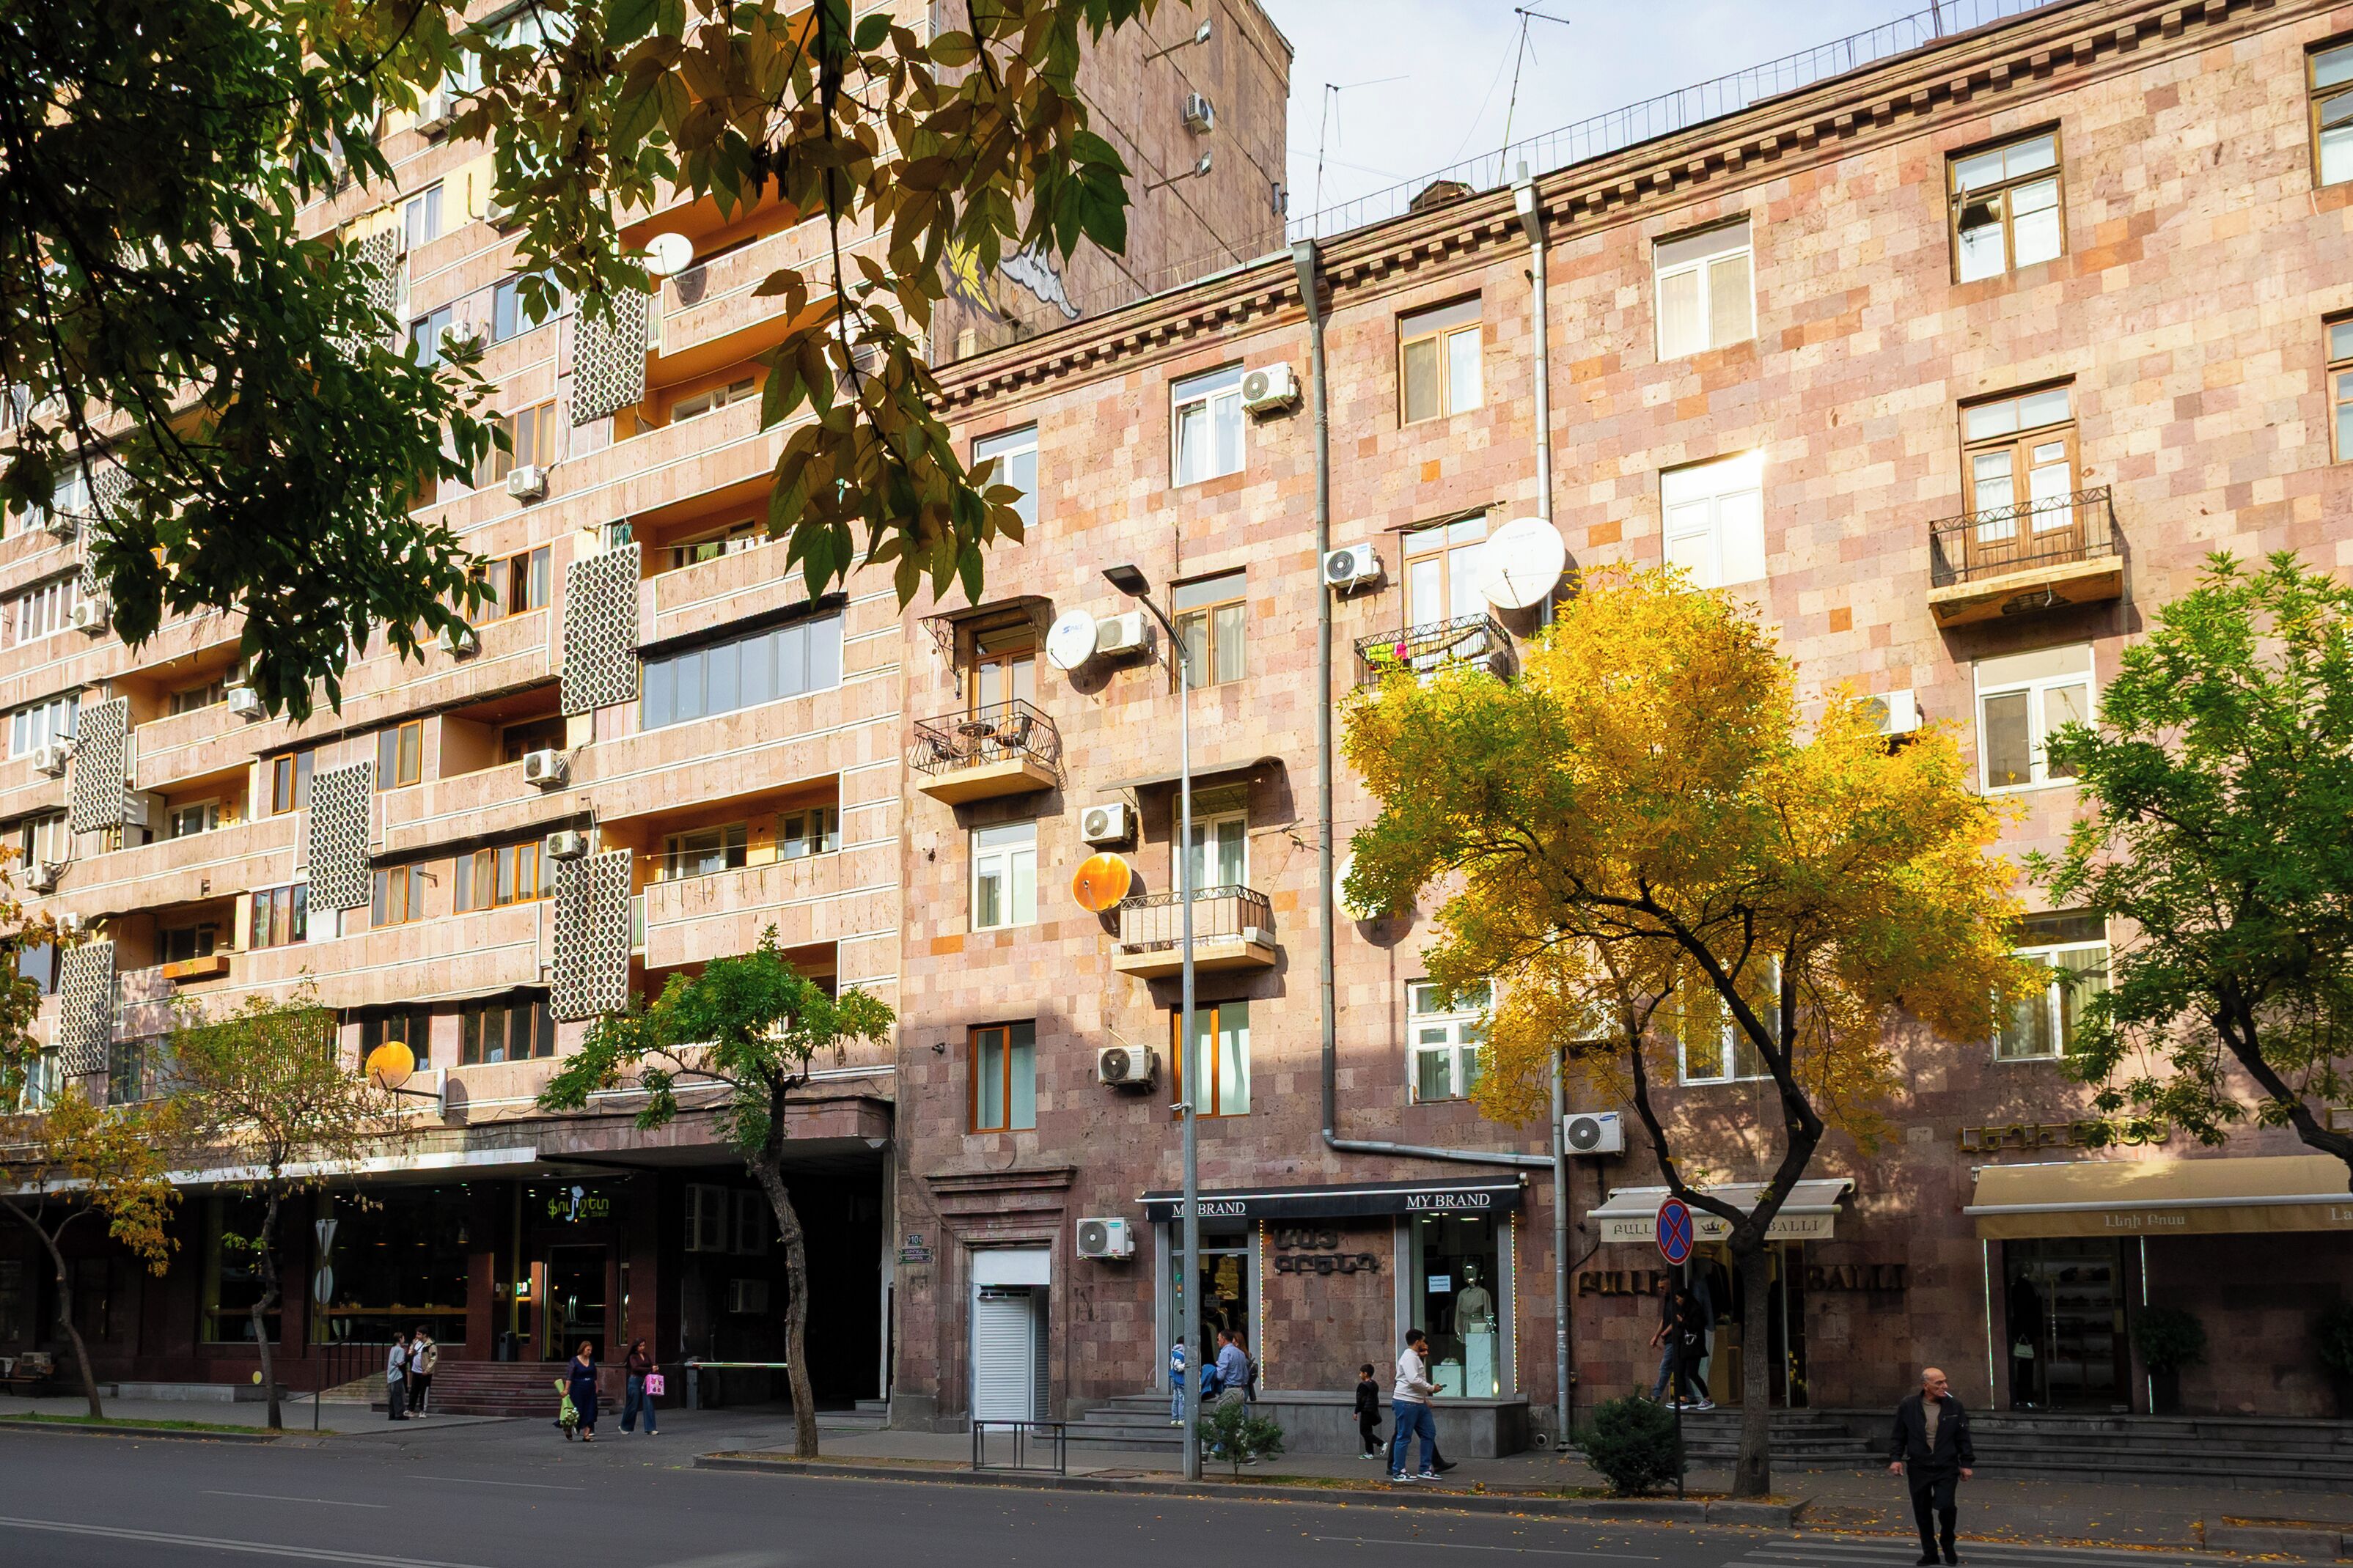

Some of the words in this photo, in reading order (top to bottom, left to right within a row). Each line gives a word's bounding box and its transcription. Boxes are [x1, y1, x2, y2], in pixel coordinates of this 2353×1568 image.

[1960, 1122, 2056, 1152] ԼԵԴԻ
[1407, 1194, 1431, 1208] MY
[1434, 1193, 1490, 1207] BRAND
[1197, 1201, 1246, 1215] BRAND
[1613, 1223, 1653, 1234] ԲԱԼԼ
[1768, 1220, 1818, 1232] BALLI
[911, 1235, 919, 1244] 10
